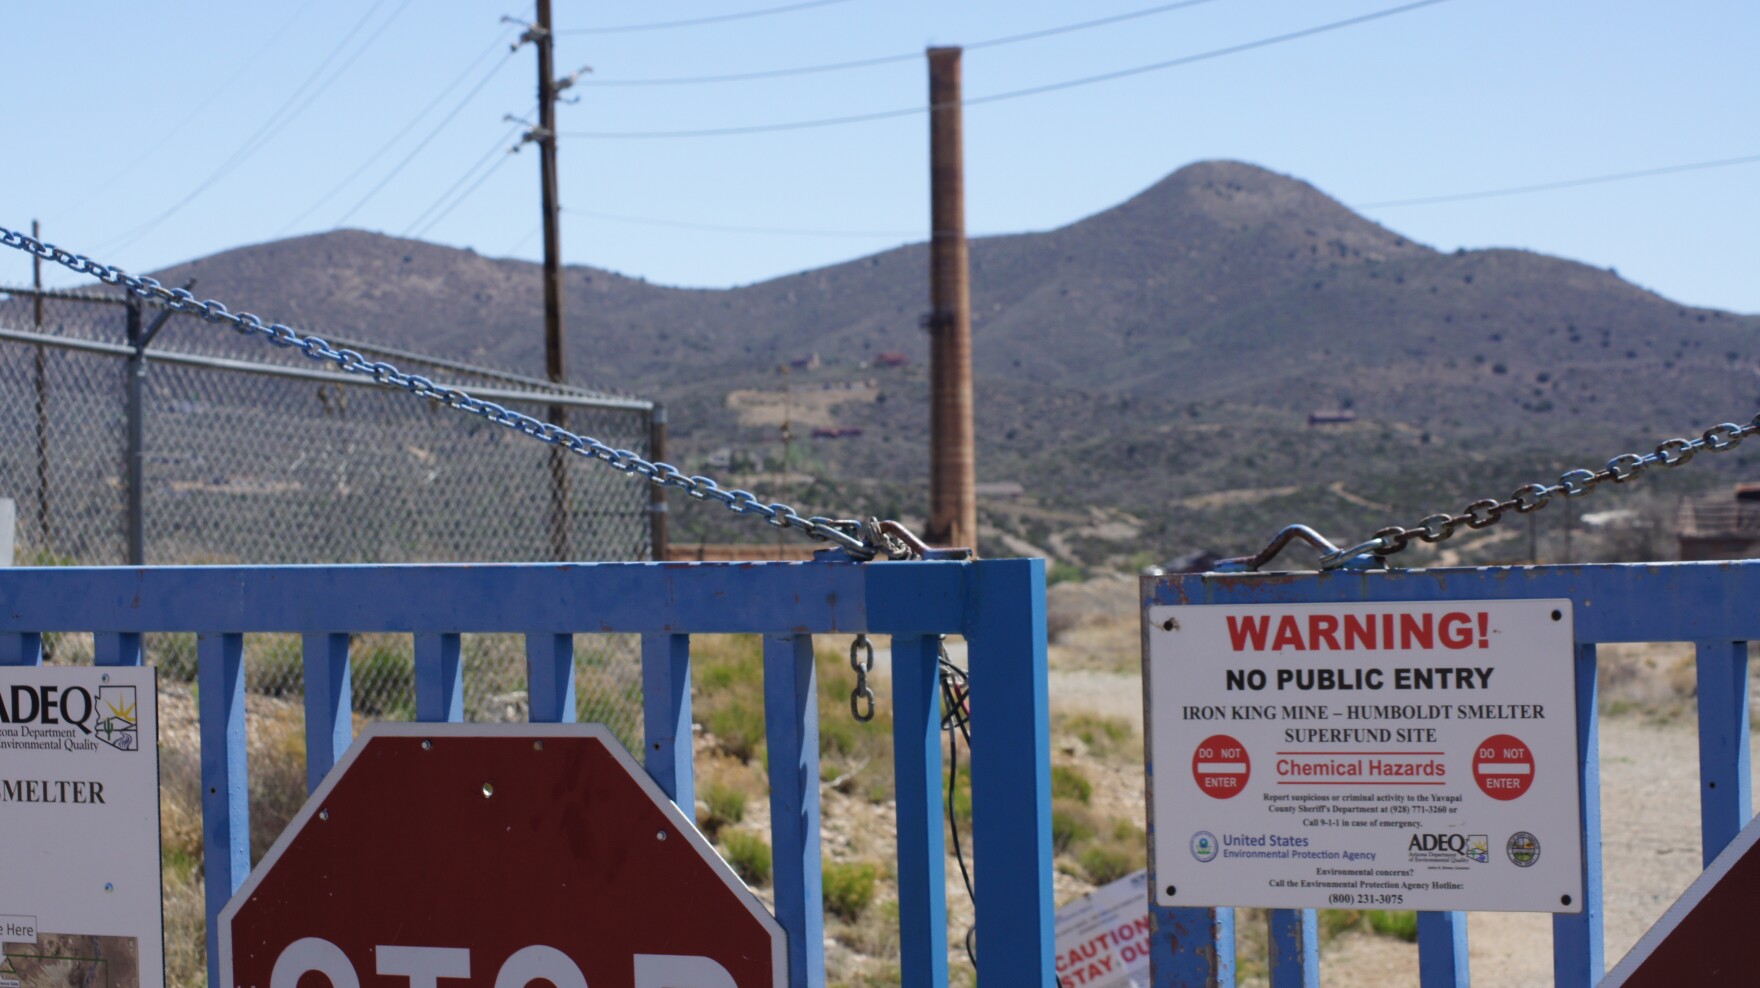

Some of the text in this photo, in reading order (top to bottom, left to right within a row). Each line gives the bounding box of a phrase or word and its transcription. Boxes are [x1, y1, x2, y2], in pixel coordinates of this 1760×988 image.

[1226, 612, 1488, 651] WARNING!
[1226, 667, 1494, 690] NO PUBLIC ENTRY
[1182, 706, 1226, 720] IRON
[1231, 706, 1276, 720] KING
[1281, 705, 1328, 720] MINE
[1347, 704, 1452, 720] HUMBOLDT
[1457, 704, 1545, 719] SMELTER
[21, 725, 76, 739] Department
[1285, 728, 1438, 743] SUPERFUND SITE
[0, 738, 99, 752] nvironmental Quality
[1199, 748, 1241, 759] DO NOT
[1479, 748, 1525, 759] DO NOT
[1276, 759, 1446, 776] Chemical Hazards
[1204, 777, 1237, 788] ENTER
[1486, 778, 1520, 789] ENTER
[0, 780, 106, 804] MELTER
[1263, 793, 1289, 803] Report
[1292, 793, 1330, 803] suspicious
[1342, 793, 1374, 802] criminal
[1377, 794, 1405, 803] activity
[1417, 794, 1429, 802] the
[1431, 794, 1463, 803] Yavapai
[1268, 804, 1296, 814] County
[1332, 805, 1379, 815] Department
[1390, 805, 1410, 814] (928)
[1412, 805, 1447, 813] 771-3260
[1449, 806, 1458, 814] or
[1302, 818, 1319, 827] Call
[1320, 818, 1339, 827] 9-1-1
[1342, 818, 1350, 827] in
[1370, 819, 1378, 827] of
[1379, 821, 1423, 829] emergency.
[1223, 834, 1309, 847] United States
[1408, 833, 1465, 855] ADEQ
[1223, 849, 1376, 861] Environmental Protection Agency
[1316, 868, 1414, 877] Environmental concerns?
[1269, 879, 1465, 891] Call the Environmental Protection Agency Hotline:
[1328, 894, 1403, 905] (800) 231-3075
[7, 923, 34, 937] Here
[1056, 915, 1150, 973] CAUTION
[1060, 953, 1113, 988] STAY
